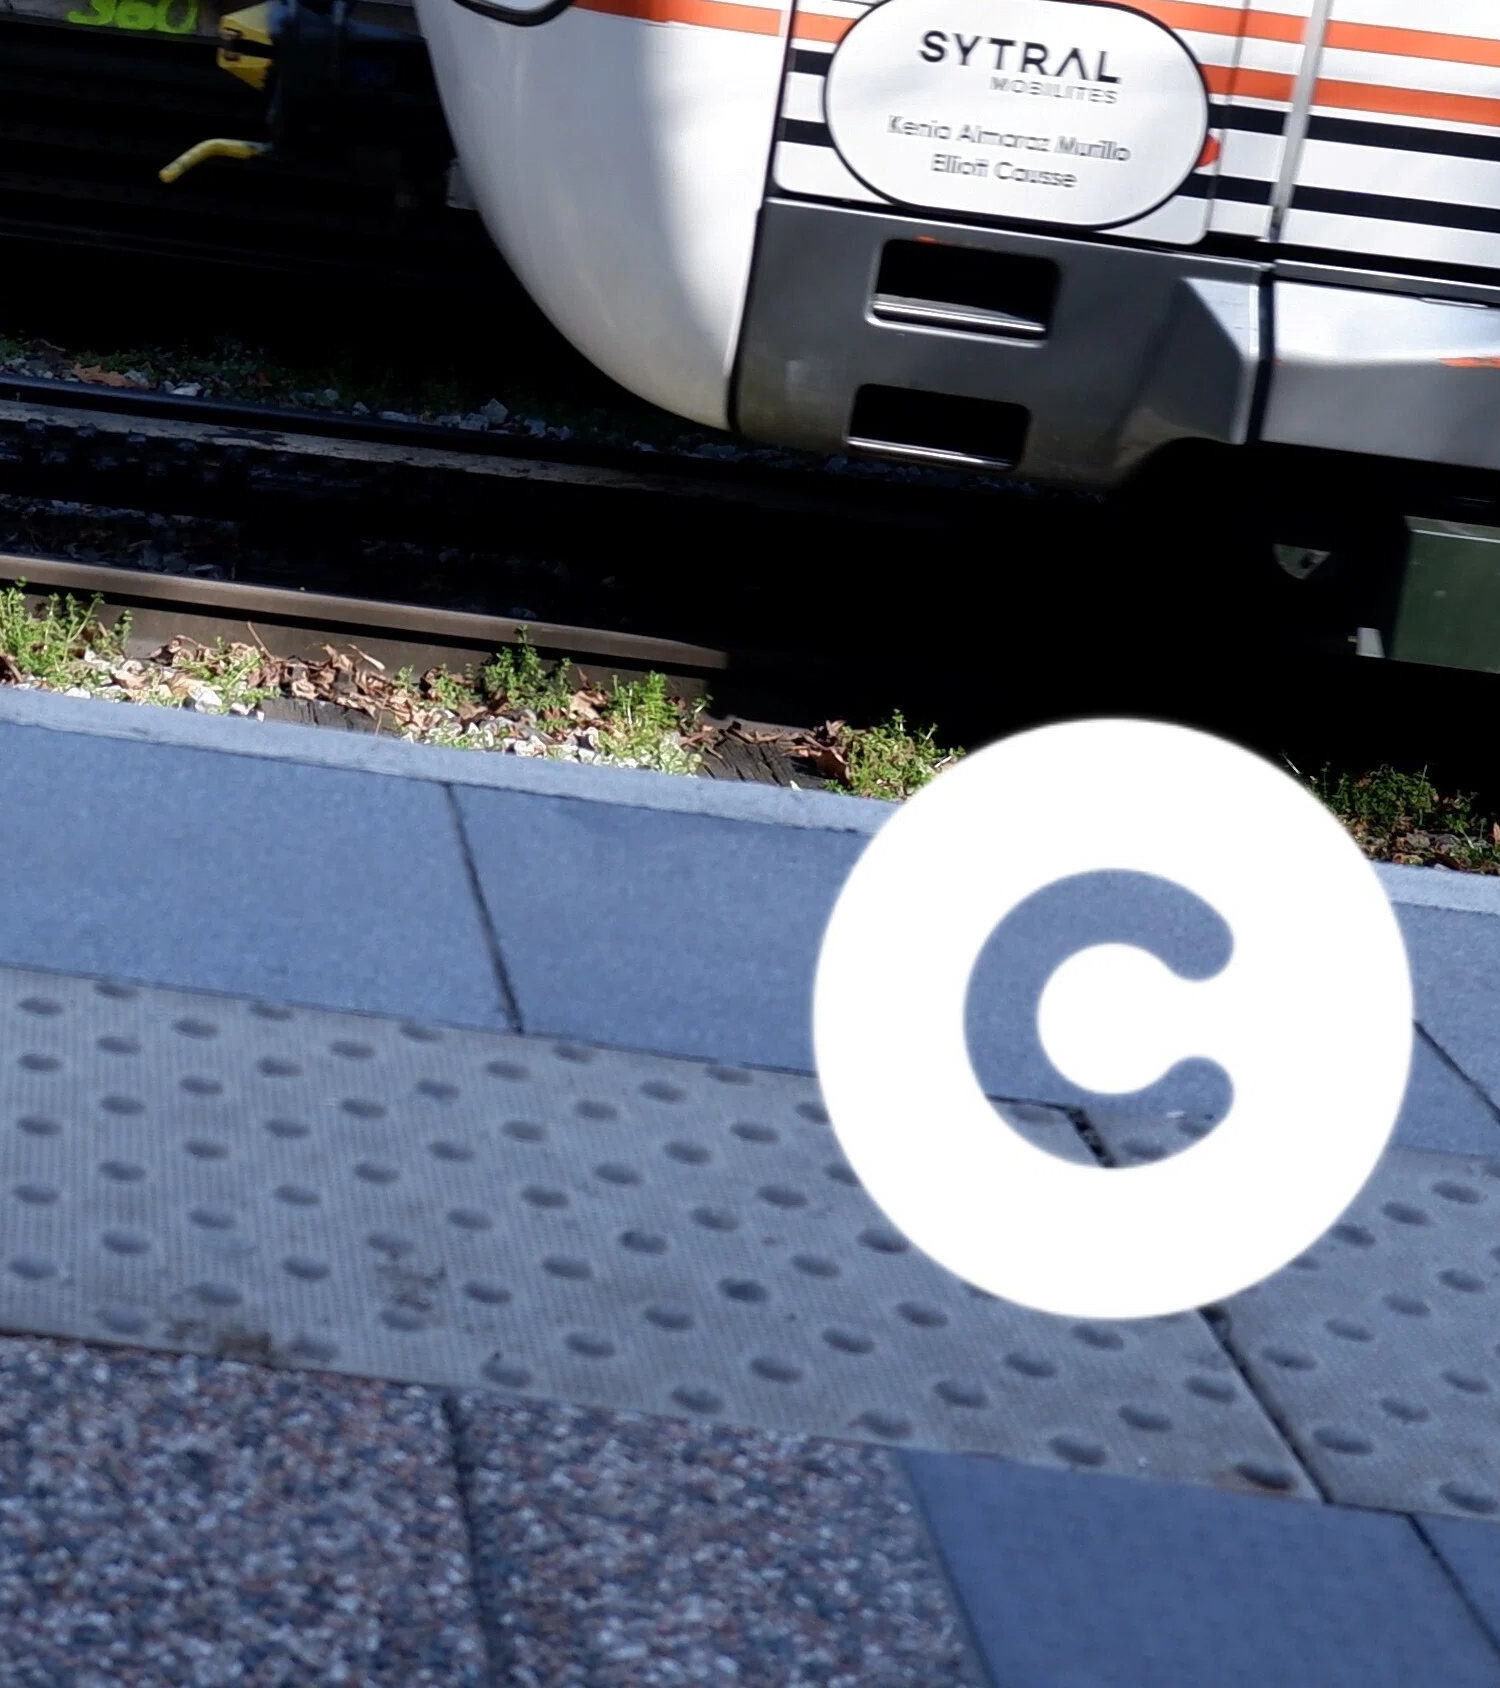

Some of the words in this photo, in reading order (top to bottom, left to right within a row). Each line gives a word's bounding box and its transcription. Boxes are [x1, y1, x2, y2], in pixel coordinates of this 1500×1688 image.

[919, 29, 1121, 85] SYTRAL
[887, 115, 951, 140] Kenia
[1054, 135, 1132, 161] Murillo
[993, 161, 1078, 188] Causse
